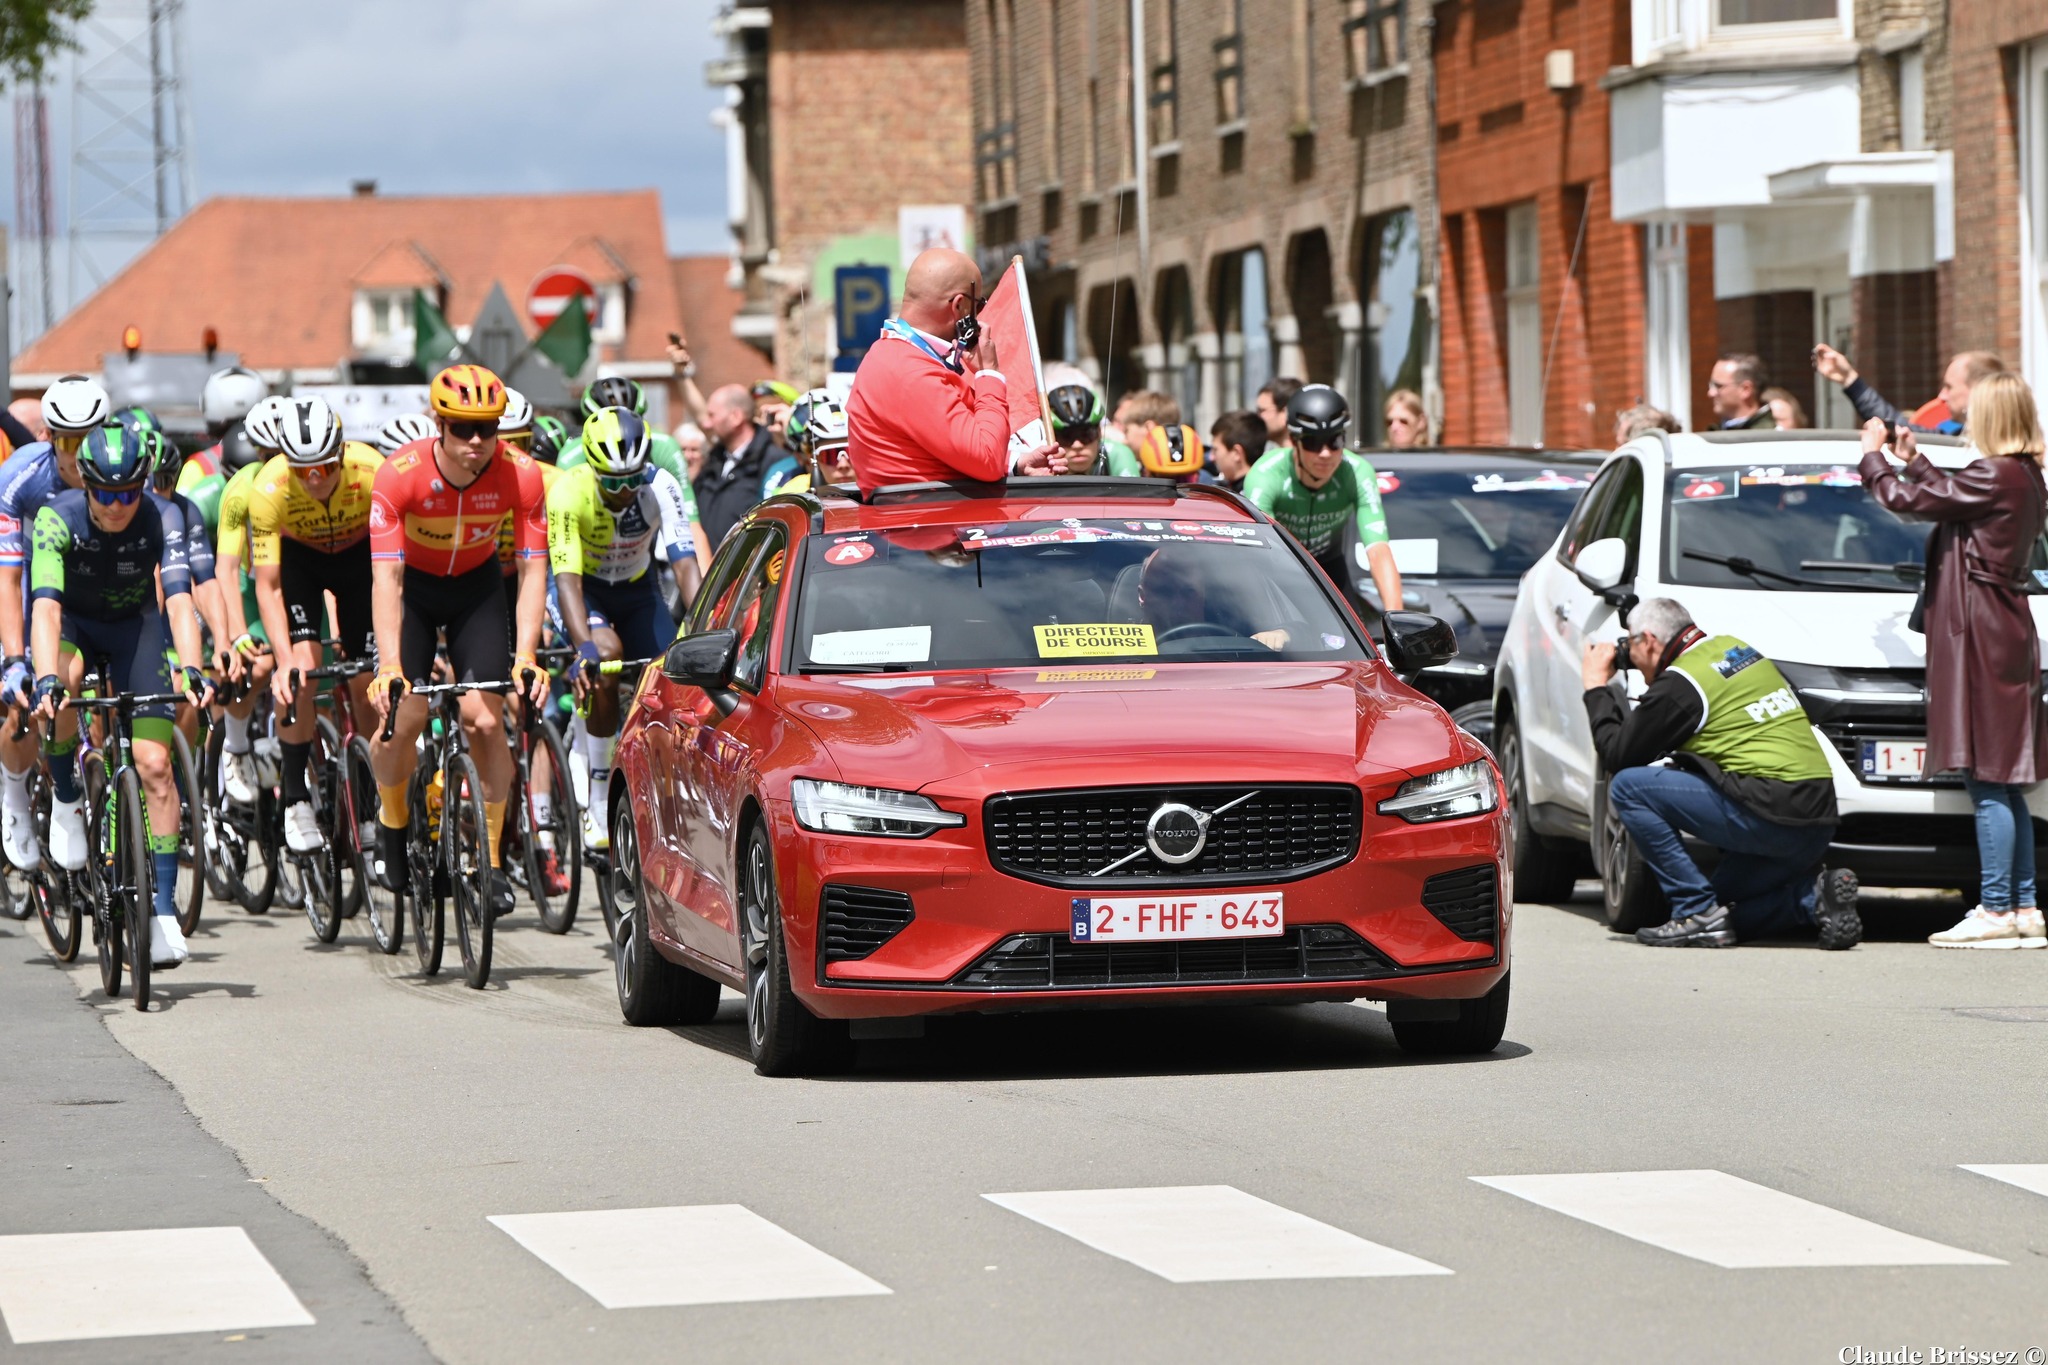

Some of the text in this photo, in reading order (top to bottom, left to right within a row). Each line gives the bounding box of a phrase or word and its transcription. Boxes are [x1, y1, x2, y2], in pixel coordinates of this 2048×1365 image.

[842, 277, 883, 339] P
[1692, 483, 1717, 496] A
[472, 493, 499, 502] REMA
[475, 501, 497, 509] 1000
[966, 528, 988, 541] 2
[981, 533, 1061, 548] DIRECTION
[835, 545, 864, 561] A
[1044, 626, 1144, 637] DIRECTEUR
[1046, 637, 1148, 648] DE COURSE
[1863, 747, 1927, 771] B 1-T
[1156, 829, 1199, 838] VOLVO
[1075, 899, 1280, 936] B 2-FHF-643
